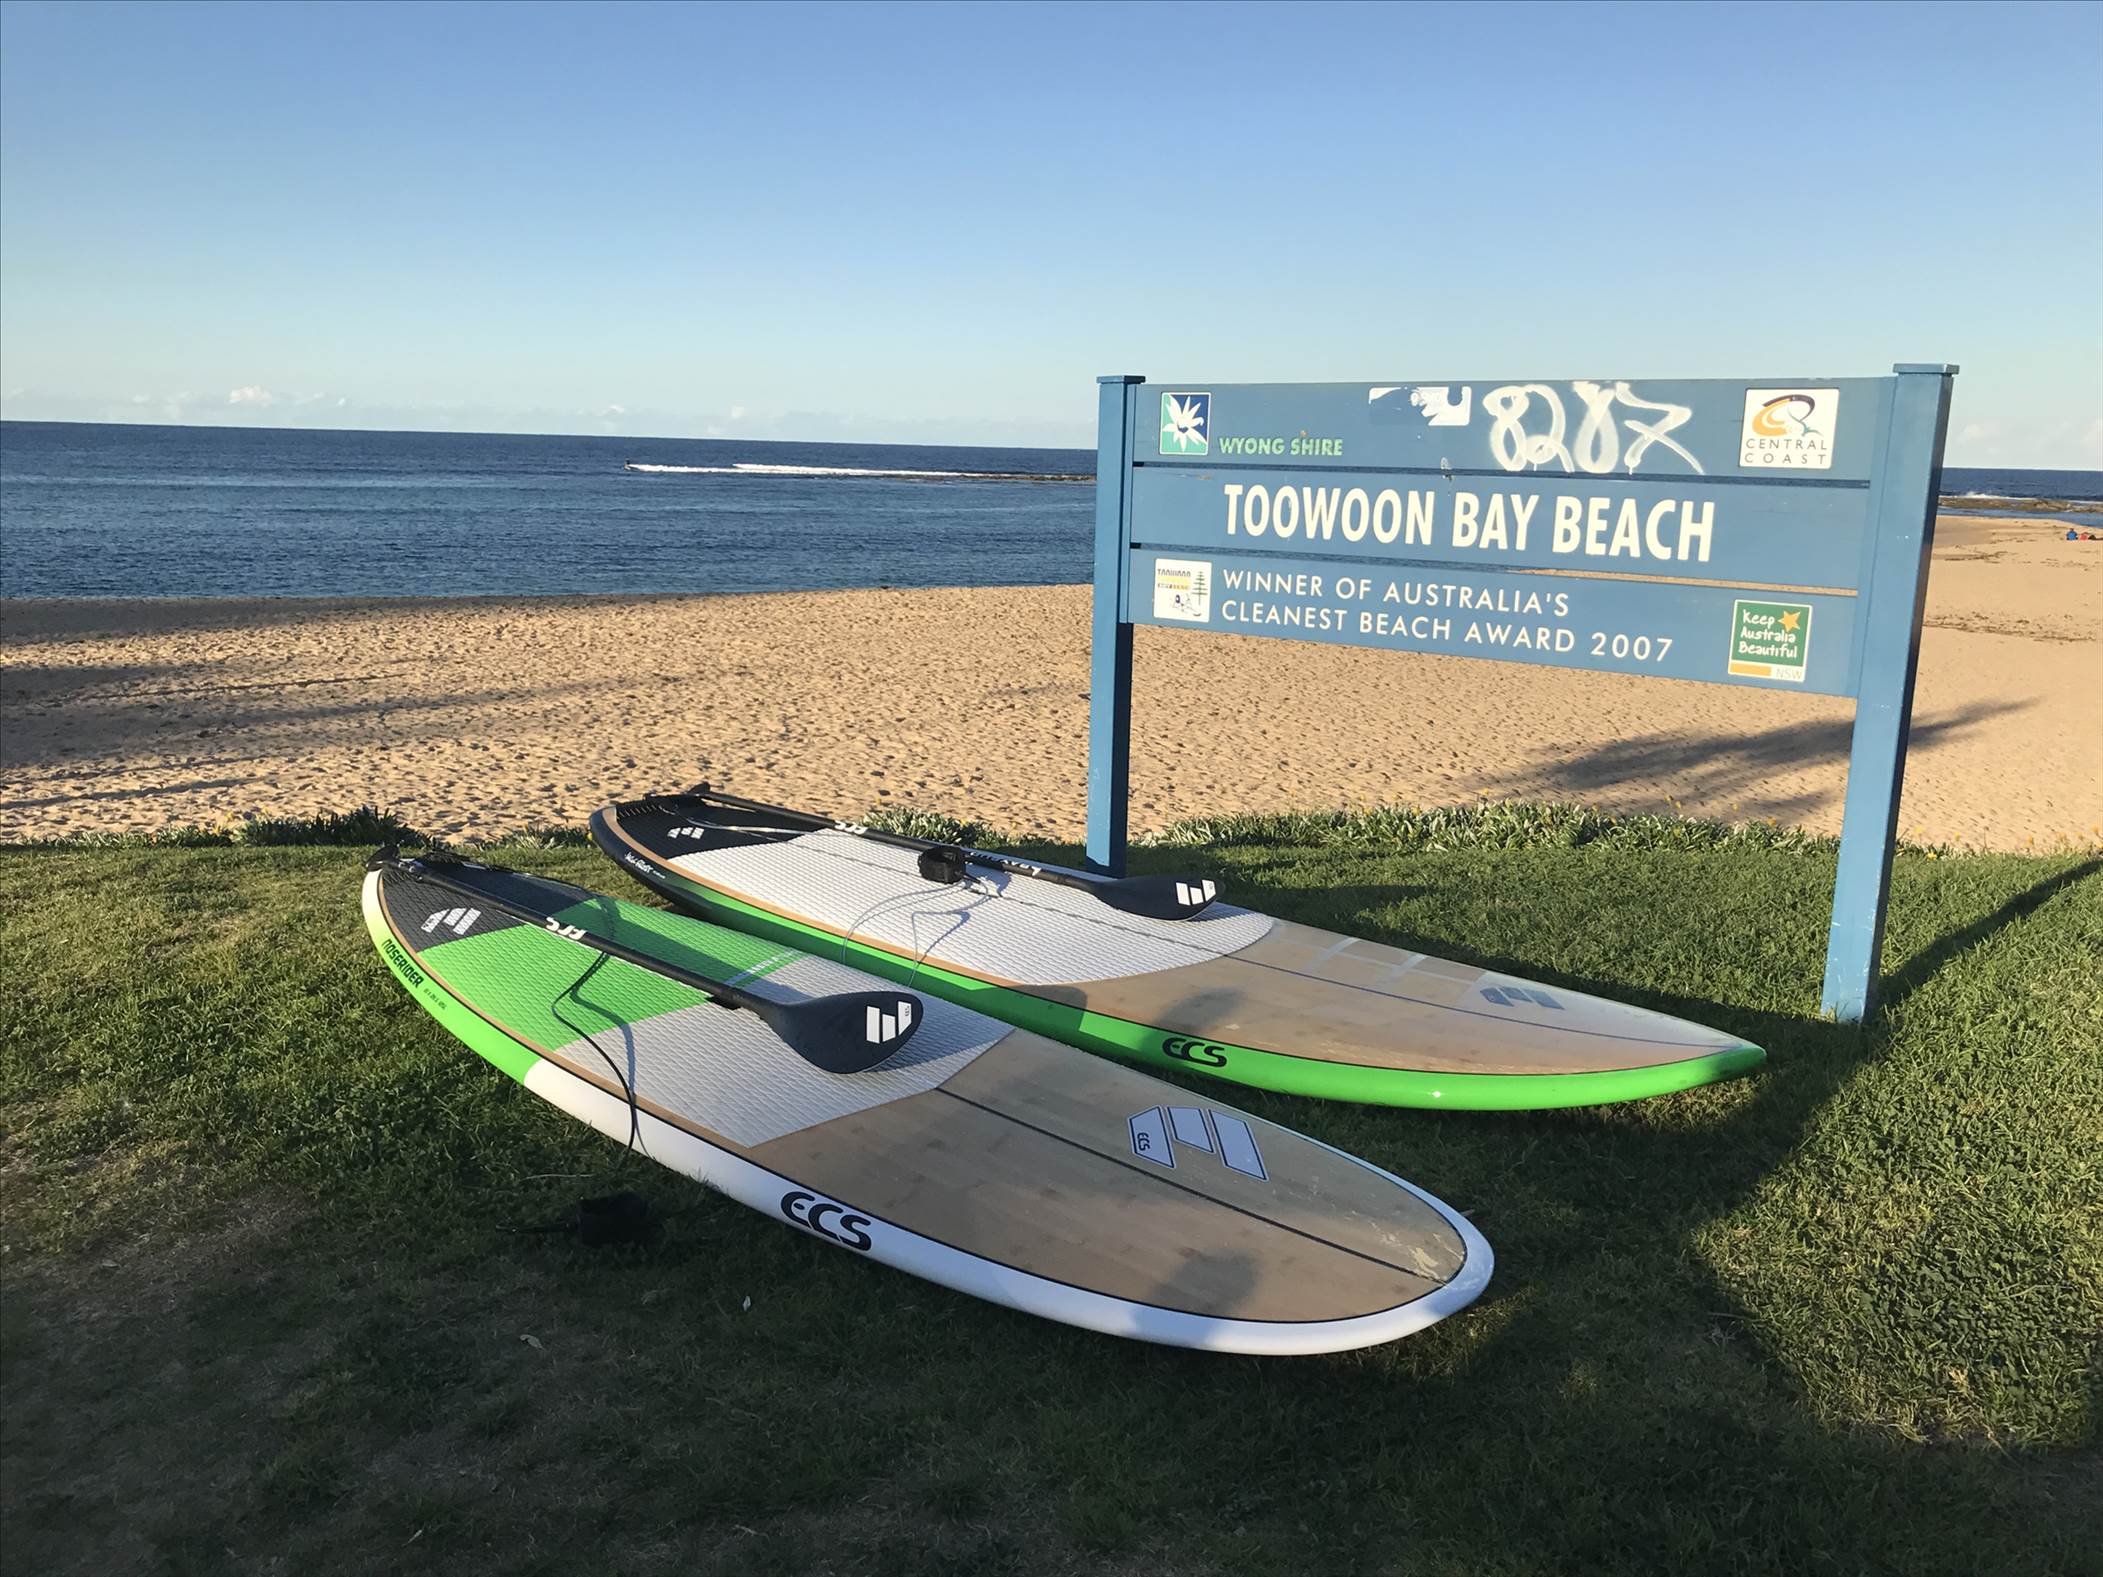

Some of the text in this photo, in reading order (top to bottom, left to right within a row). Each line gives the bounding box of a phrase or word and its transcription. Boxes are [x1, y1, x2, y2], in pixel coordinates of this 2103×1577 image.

[1219, 437, 1343, 456] WYONG SHIRE
[1746, 438, 1827, 450] CENTRAL
[1744, 452, 1827, 464] COAST
[1224, 484, 1715, 562] TOOWOON BAY BEACH
[1223, 569, 1569, 617] WINNER OF AUSTRALIA'S
[1742, 609, 1775, 629] Keep
[1222, 600, 1673, 662] CLEANEST BEACH AWARD 2007
[1740, 626, 1796, 643] Australia
[1738, 640, 1798, 658] Beautiful
[381, 938, 424, 989] NOSERIDER
[1162, 1037, 1228, 1068] ECS
[1136, 1132, 1151, 1151] ECS
[780, 1191, 872, 1252] ECS
